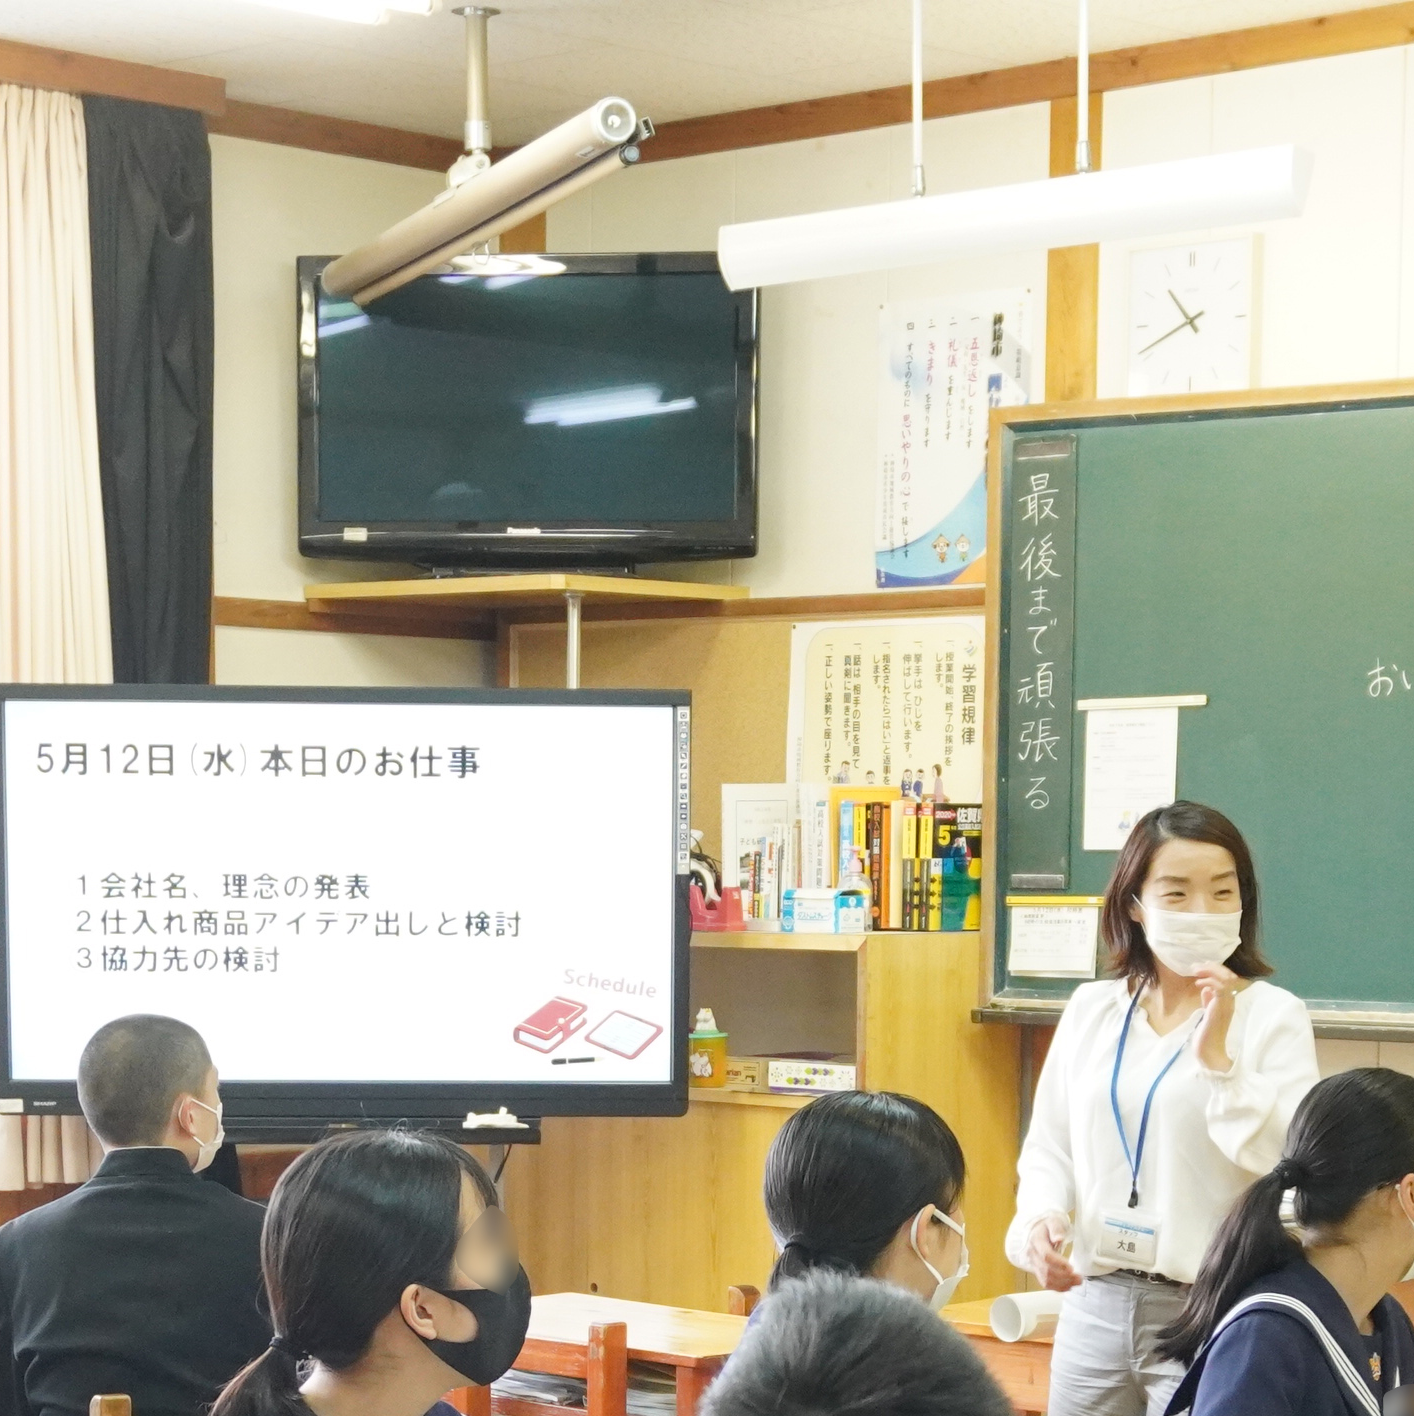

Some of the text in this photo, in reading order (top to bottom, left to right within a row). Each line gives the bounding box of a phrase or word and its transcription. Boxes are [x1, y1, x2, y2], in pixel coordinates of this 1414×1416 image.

[925, 339, 937, 387] きまり
[947, 338, 959, 368] 礼儀
[1018, 472, 1062, 810] 最後まで頑張る
[872, 653, 882, 689] します。
[935, 651, 944, 688] します。
[843, 654, 853, 747] 真剣に聞きます。
[902, 653, 913, 759] 伸ばして行います。
[962, 663, 977, 745] 学習規律
[957, 807, 982, 824] 佐賀
[938, 824, 951, 846] 5
[563, 968, 657, 999] Schedule
[1117, 1239, 1136, 1254] 大島
[1118, 1228, 1139, 1238] スタッフ
